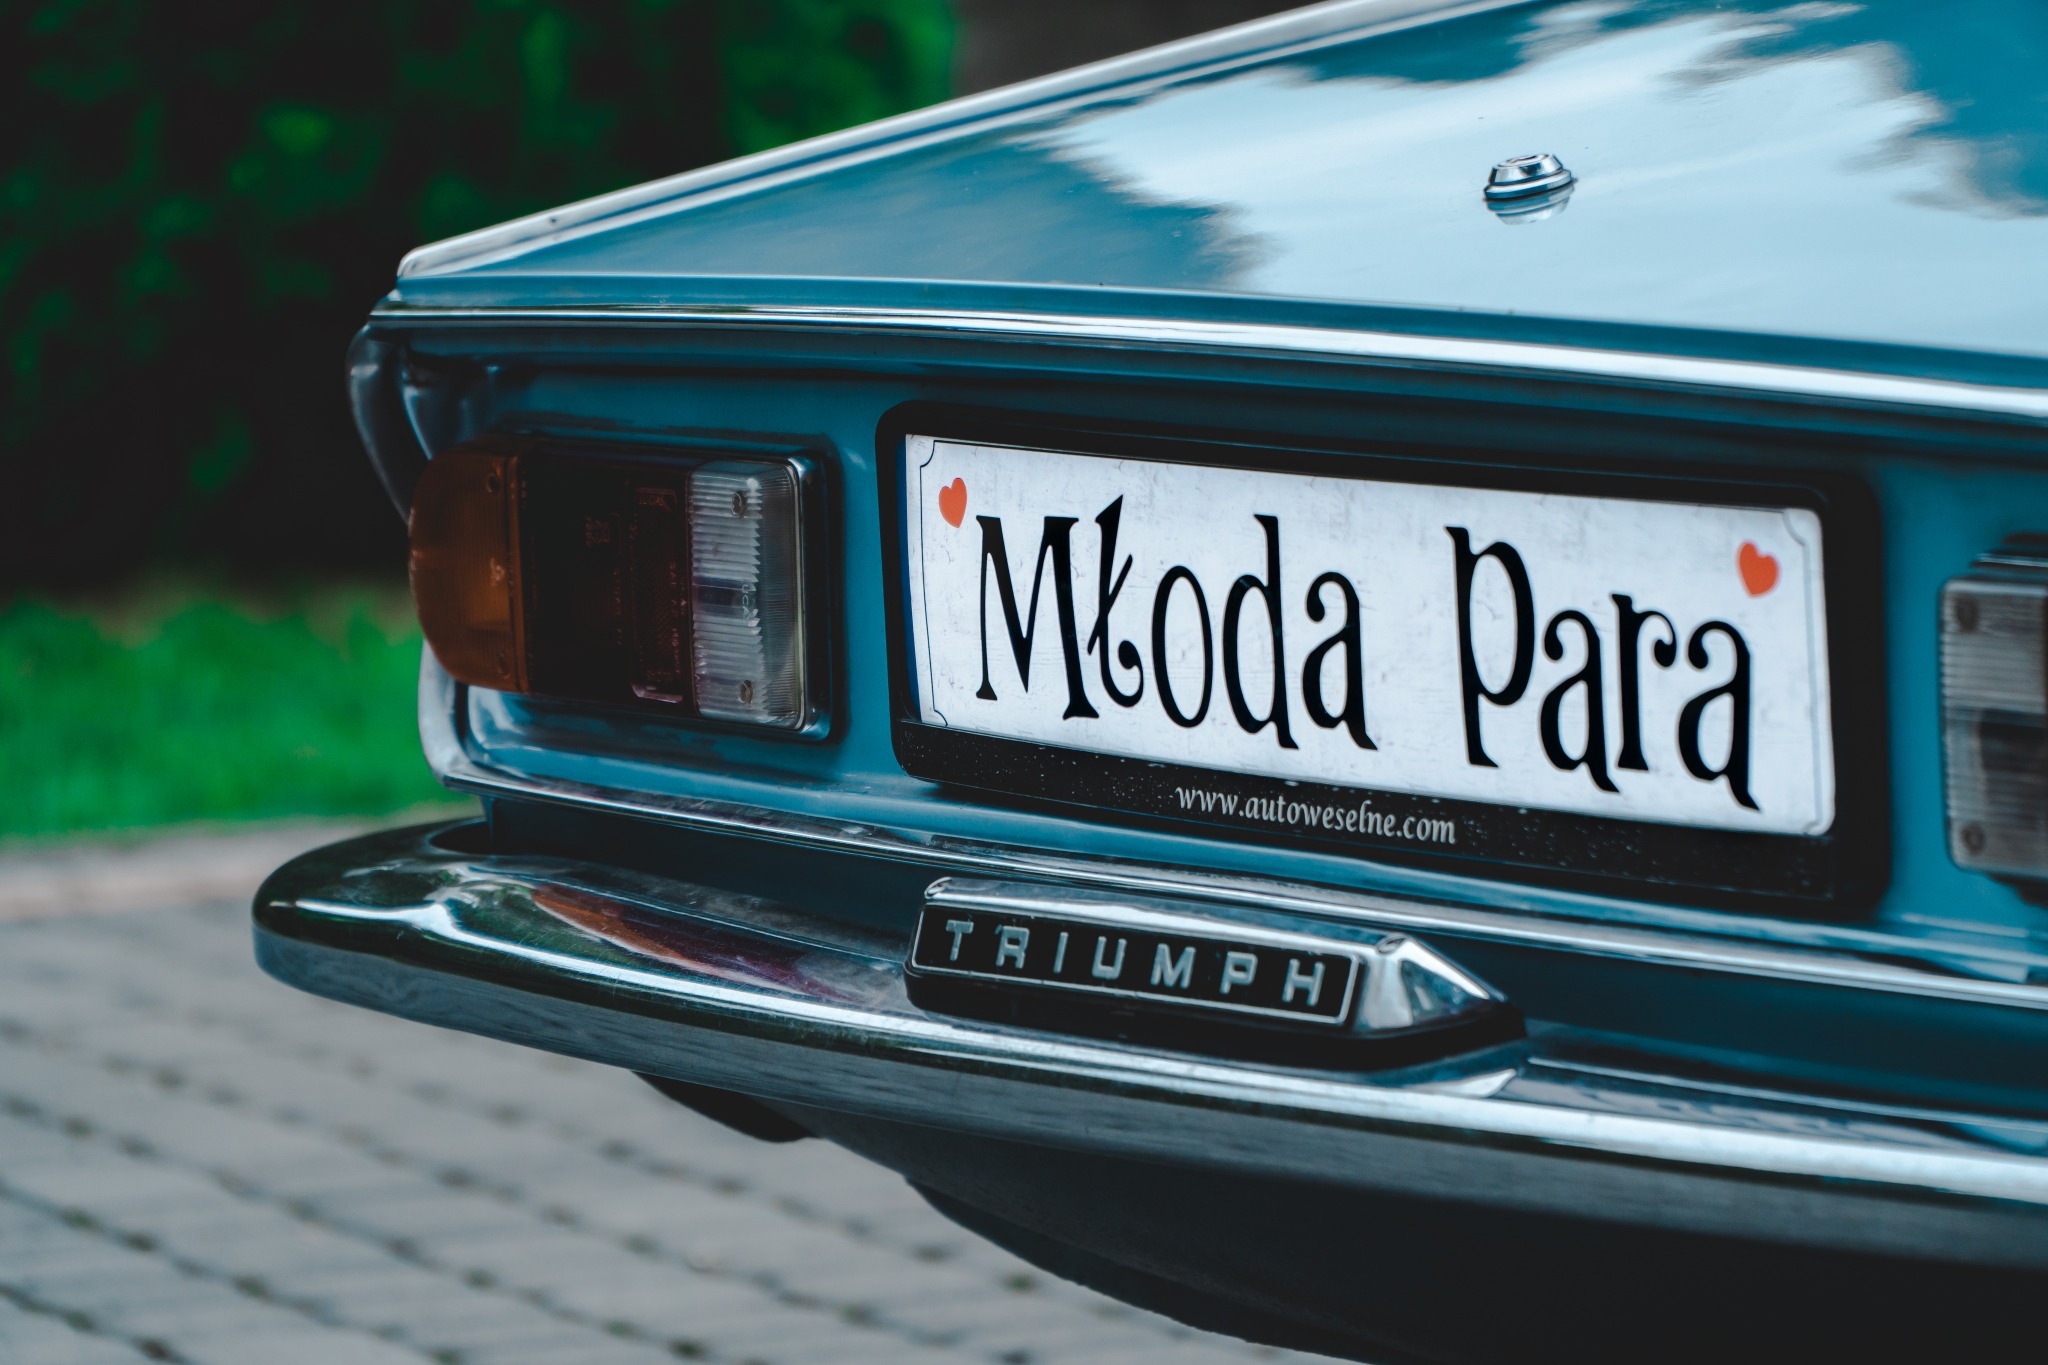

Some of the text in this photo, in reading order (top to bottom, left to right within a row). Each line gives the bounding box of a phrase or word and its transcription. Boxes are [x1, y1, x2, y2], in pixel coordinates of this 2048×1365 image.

[975, 494, 1378, 751] Młoda
[1445, 526, 1761, 812] Para
[1175, 786, 1456, 845] www.autoweselne.com
[945, 918, 1325, 1007] TRIUMPH
